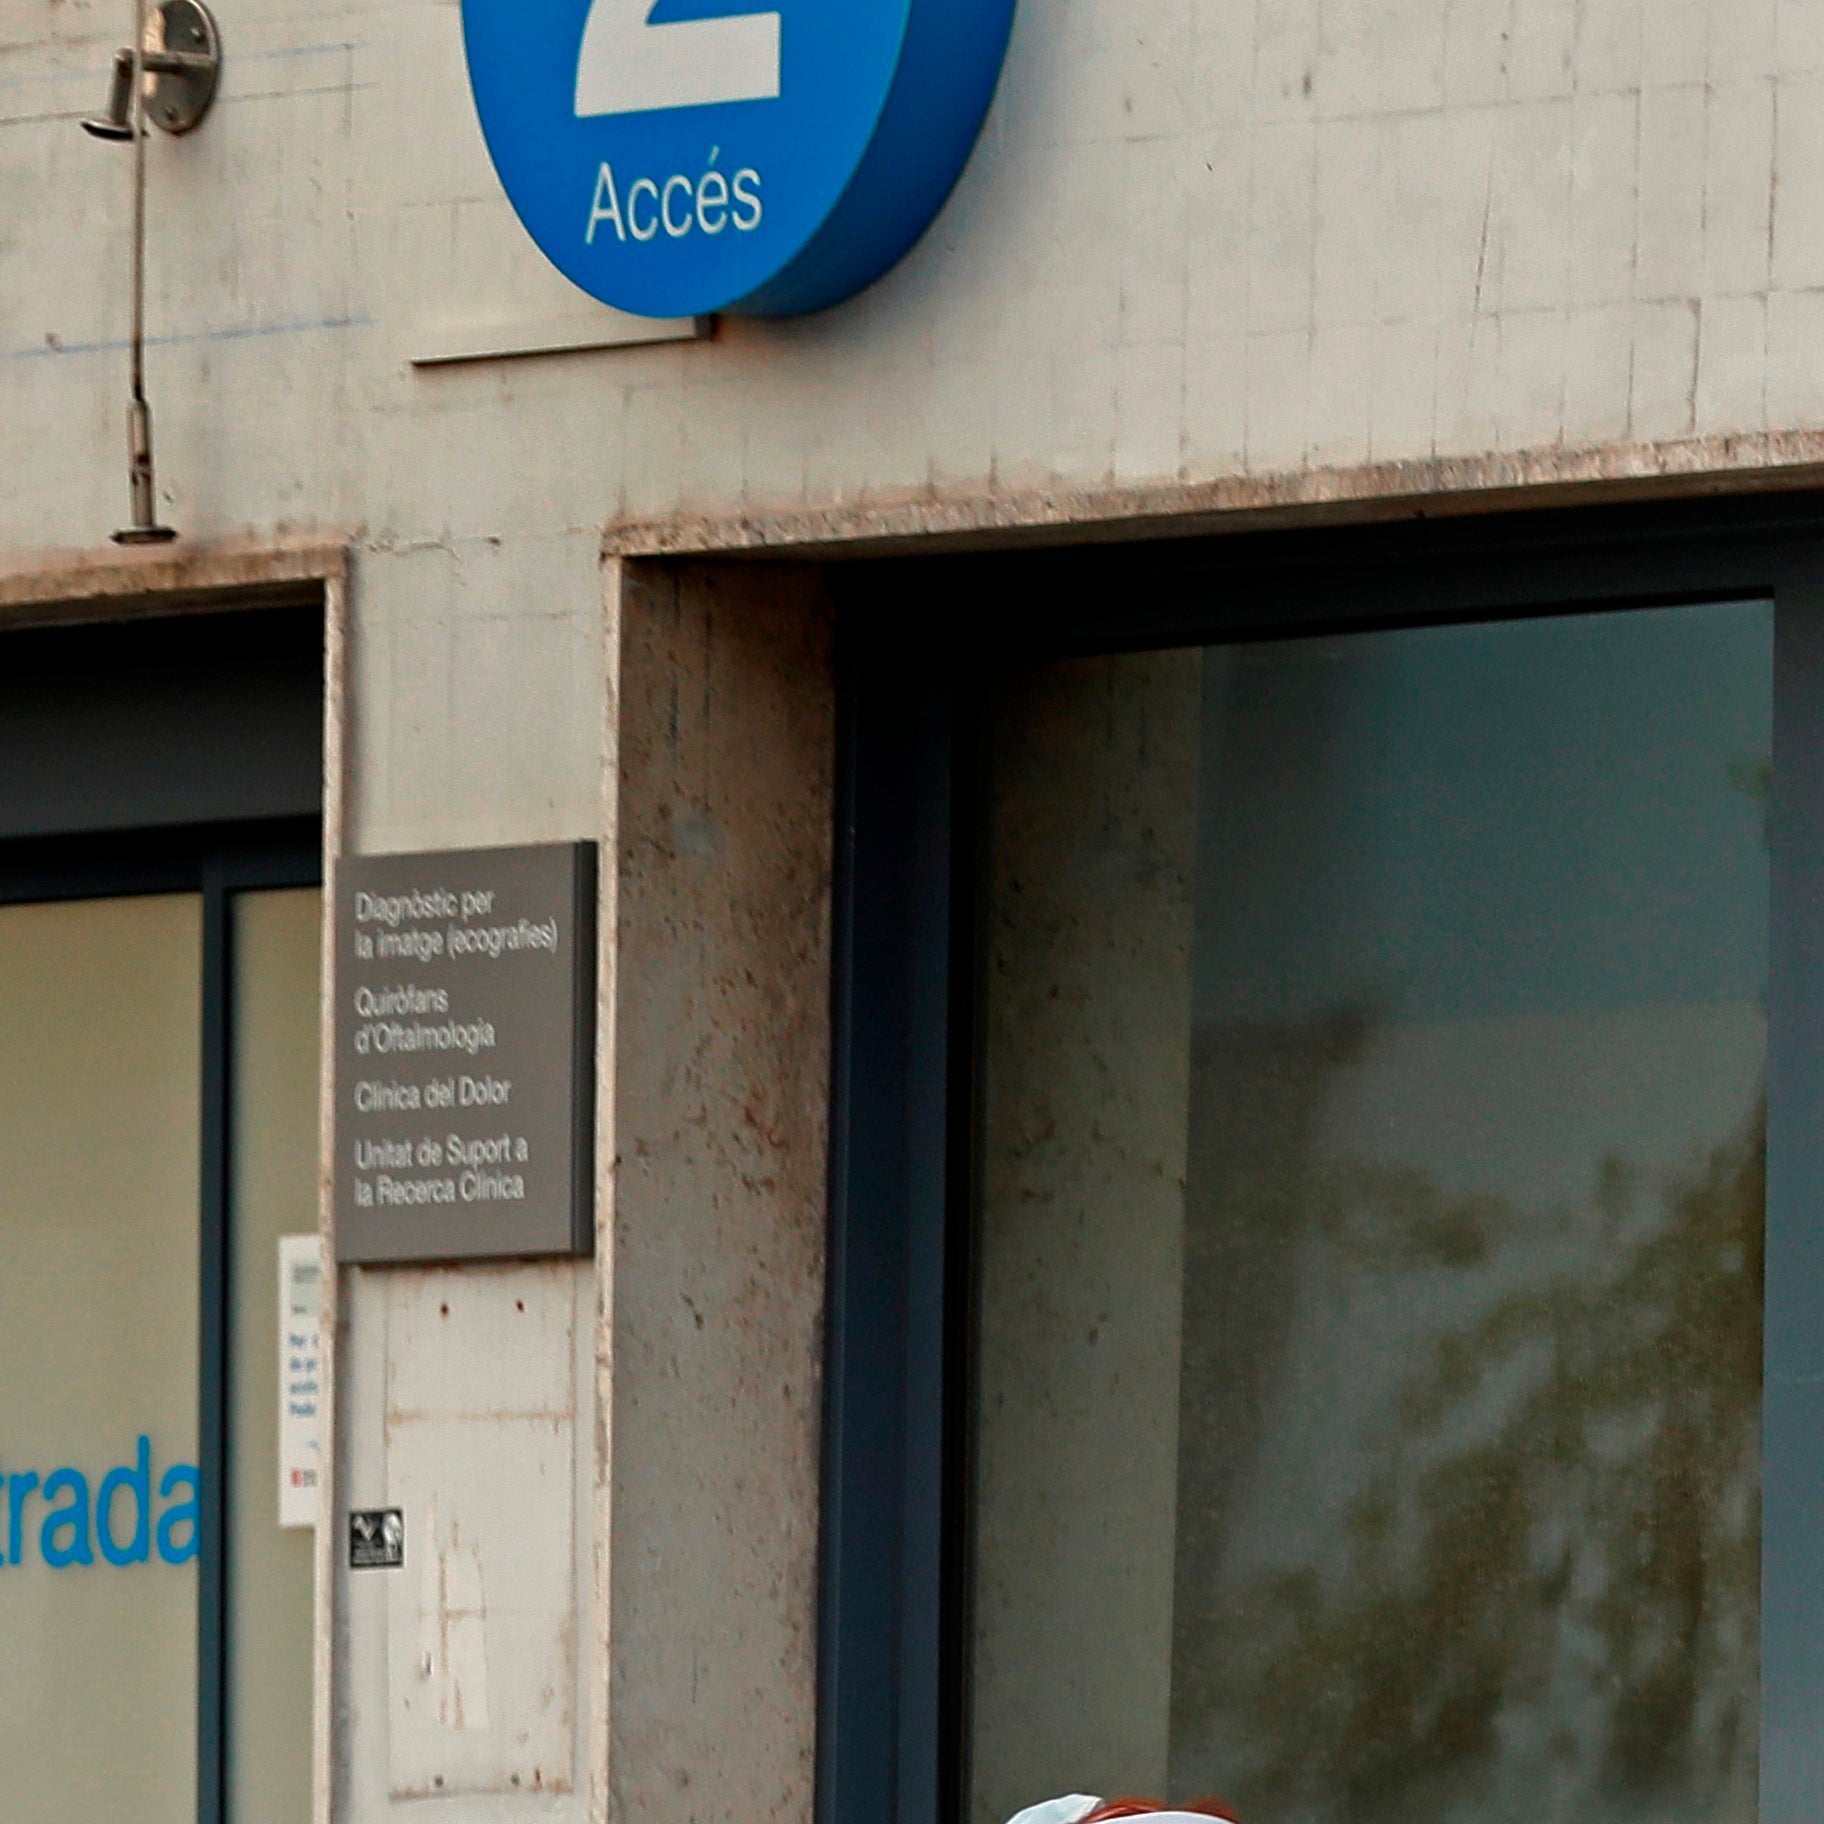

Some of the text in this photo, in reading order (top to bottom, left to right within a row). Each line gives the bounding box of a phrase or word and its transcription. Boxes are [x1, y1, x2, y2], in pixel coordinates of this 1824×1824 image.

[585, 146, 763, 245] Accés
[355, 889, 495, 926] Diagnòstic per
[355, 917, 558, 962] la imatge (ecografies)
[354, 985, 449, 1019] Quiròfans
[425, 1077, 454, 1108] del
[459, 1075, 511, 1106] Dolor
[355, 1134, 528, 1171] Unitat de Suport a
[355, 1179, 373, 1207] la
[377, 1175, 454, 1205] Recerca
